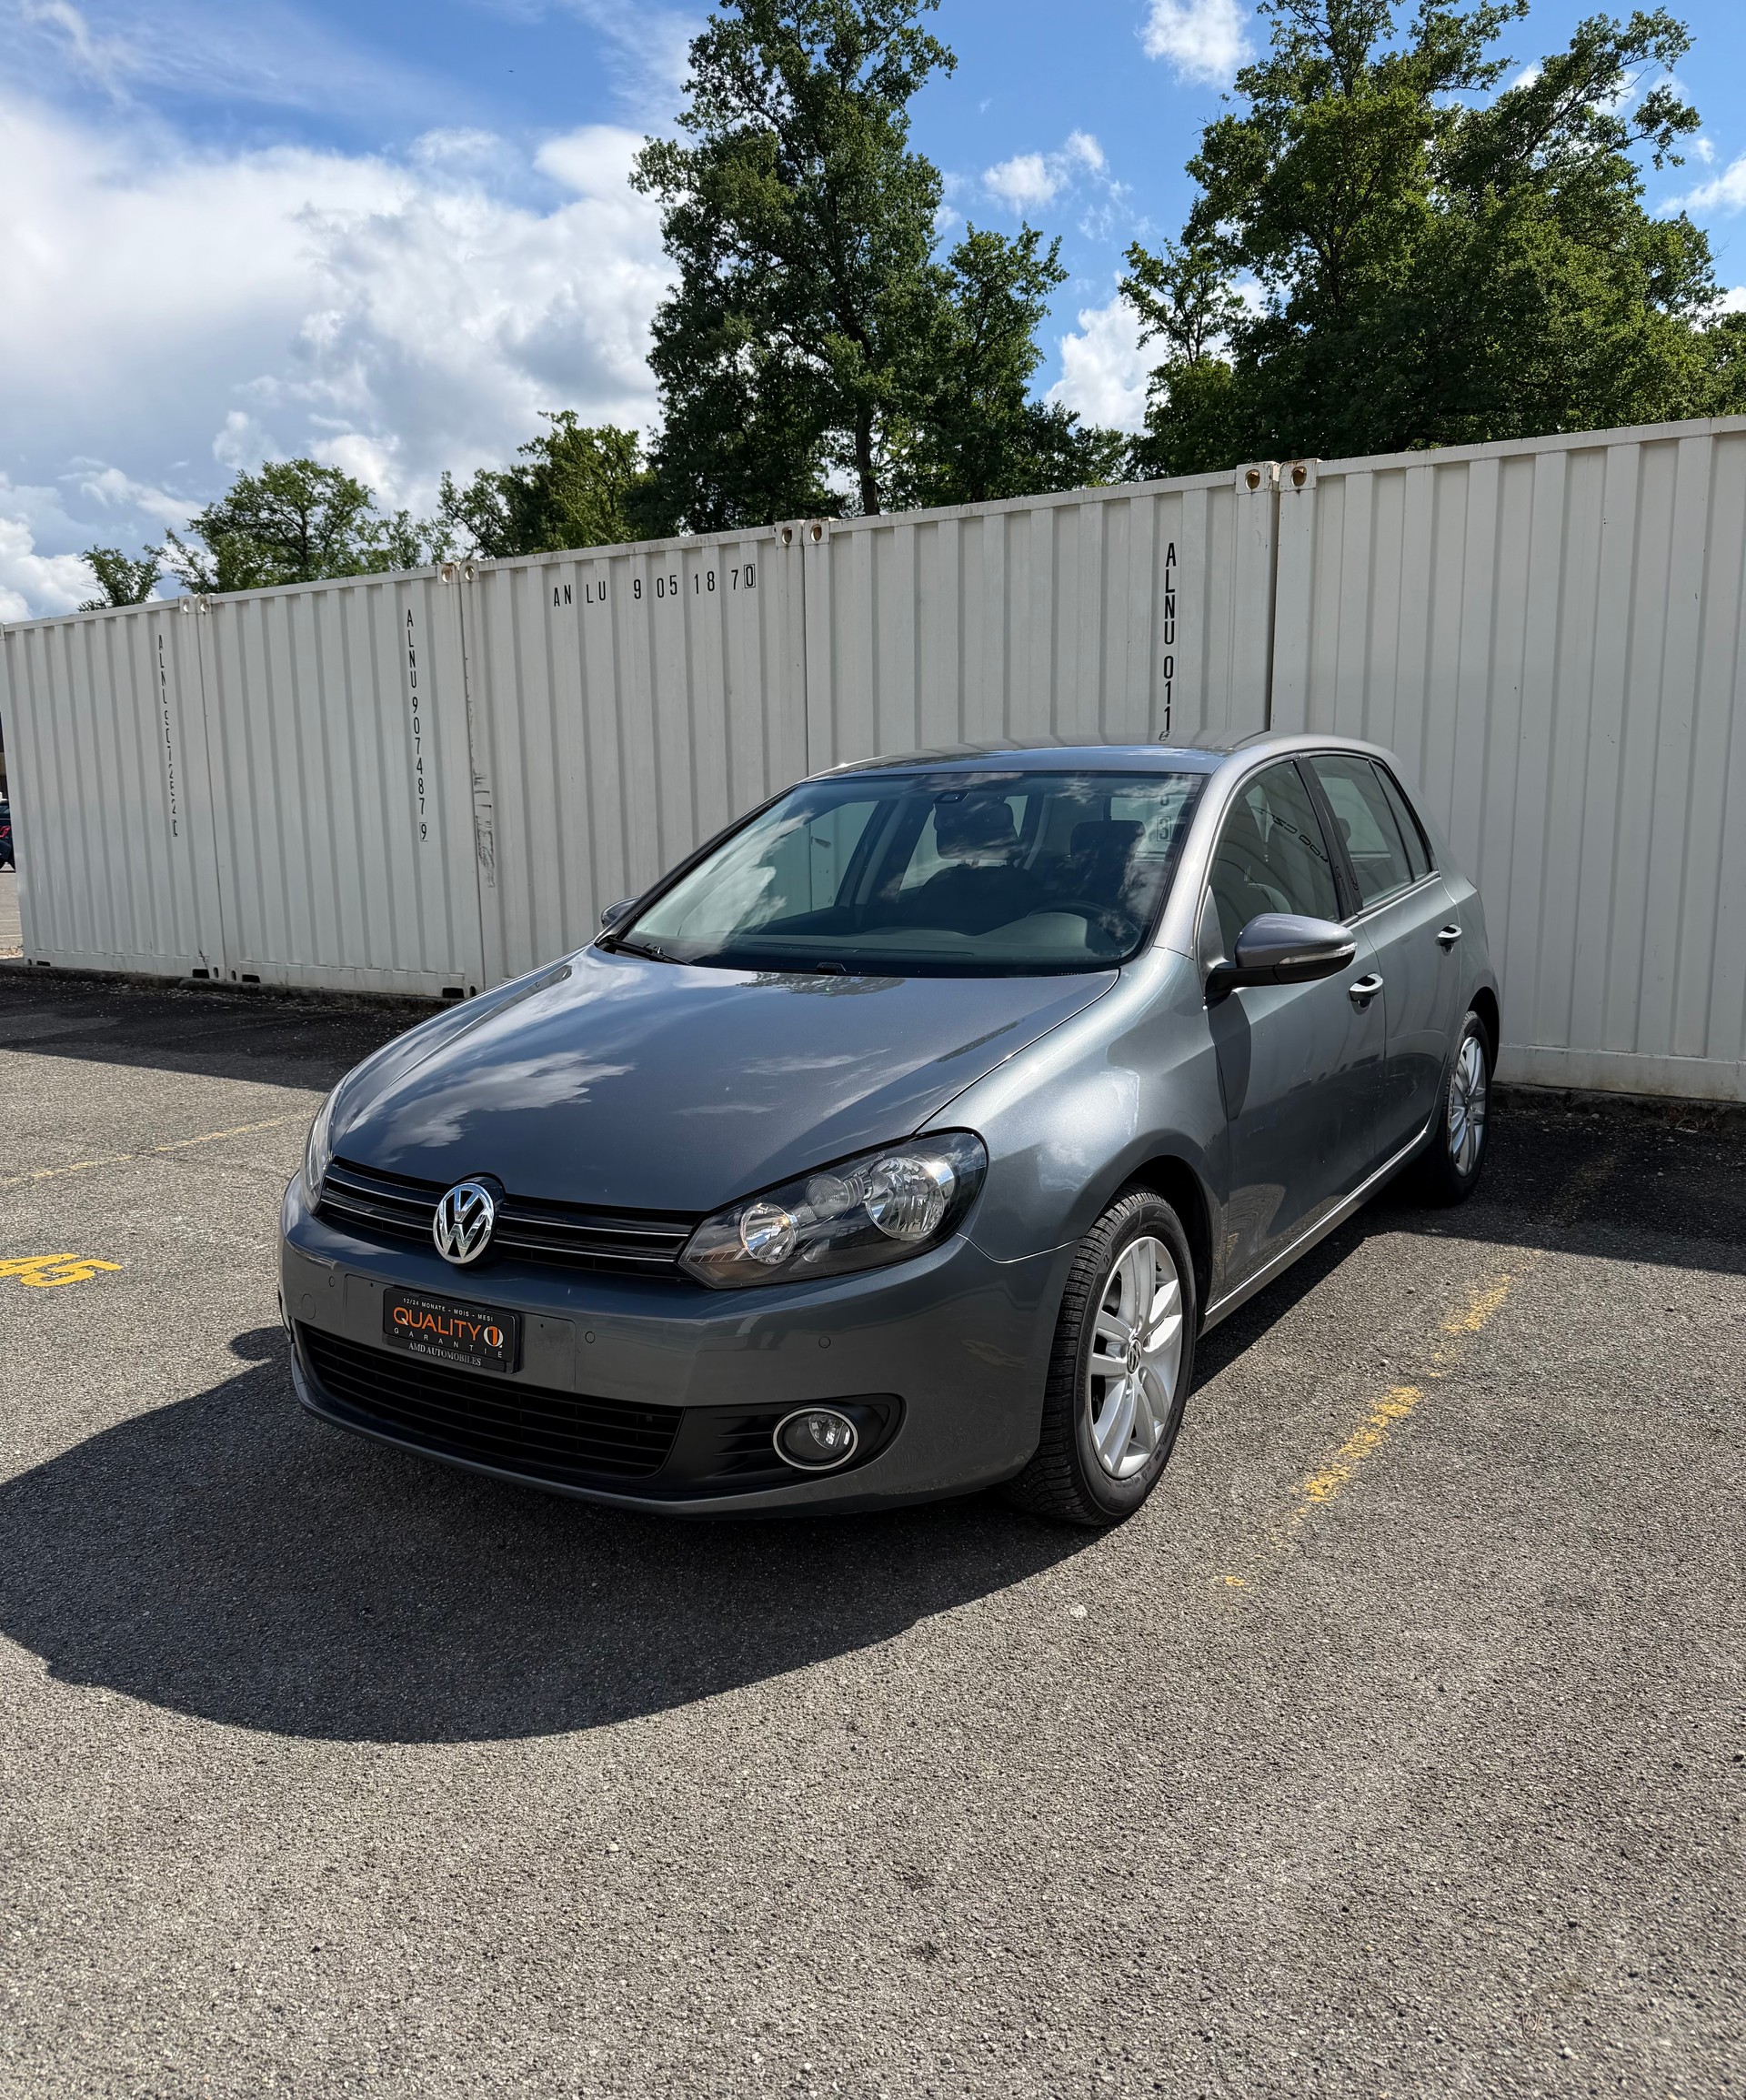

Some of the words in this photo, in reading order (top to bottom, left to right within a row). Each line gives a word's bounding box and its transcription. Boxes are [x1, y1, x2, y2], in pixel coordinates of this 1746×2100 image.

[1164, 542, 1177, 645] ALNU
[406, 608, 417, 688] ALNU
[434, 1184, 495, 1264] VW
[403, 1298, 419, 1306] 12/24
[422, 1301, 446, 1312] MONATE
[454, 1308, 469, 1317] MOIS
[477, 1313, 494, 1322] MESI
[394, 1327, 503, 1359] GARANTIE
[409, 1342, 426, 1353] AMD
[426, 1344, 482, 1367] AUTOMOBILES
